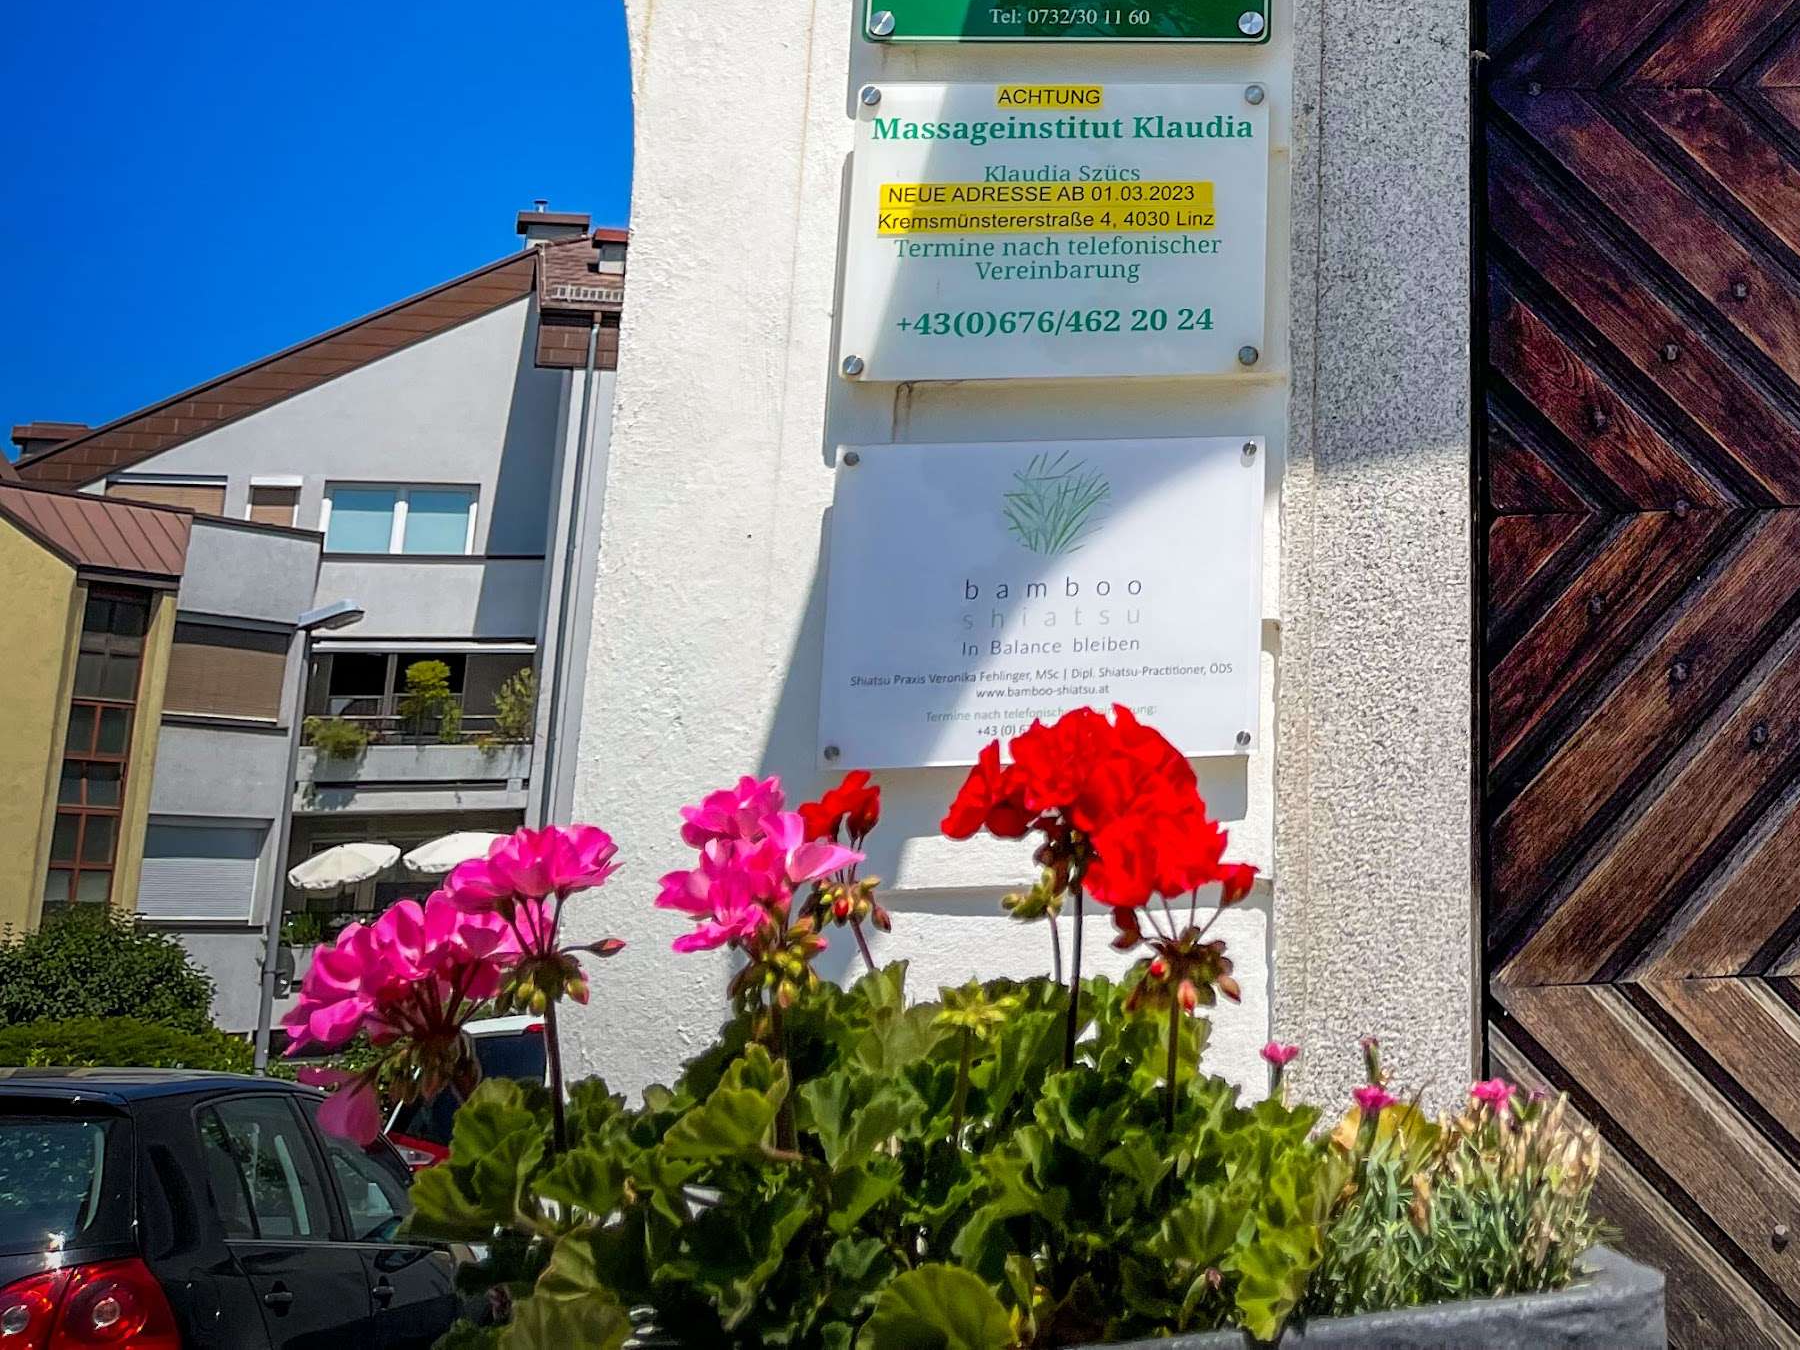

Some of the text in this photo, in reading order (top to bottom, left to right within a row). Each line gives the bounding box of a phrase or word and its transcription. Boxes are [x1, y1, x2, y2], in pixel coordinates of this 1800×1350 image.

[990, 9, 1150, 25] Tel: 0732/30 11 60
[998, 89, 1101, 105] ACHTUNG
[872, 115, 1253, 146] Massageinstitut Klaudia
[985, 165, 1140, 183] Klaudia Szücs
[888, 185, 1195, 203] NEUE ADRESSE AB 01.03.2023
[879, 211, 1214, 230] Kremsmünstererstraße 4, 4030 Linz
[894, 235, 1221, 258] Termine nach telefonischer
[976, 260, 1141, 283] Vereinbarung
[897, 308, 1214, 337] +43(0)676/462 20 24
[965, 577, 1143, 600] bamboo
[962, 606, 1141, 631] shiatsu
[962, 636, 1140, 656] In Balance bleiben
[850, 675, 891, 686] Shiatsu
[894, 674, 926, 684] Praxis
[928, 672, 977, 683] Veronika
[980, 670, 1032, 683] Fehlinger,
[1036, 669, 1059, 680] MSc
[1072, 668, 1096, 679] Dipl.
[1099, 665, 1207, 678] Shiatsu-Practitioner,
[976, 683, 1110, 700] www.bamboo-shiatsu.at
[926, 711, 970, 722] Termine
[974, 709, 1000, 719] nach
[978, 726, 997, 736] +43
[1001, 725, 1016, 737] (0)
